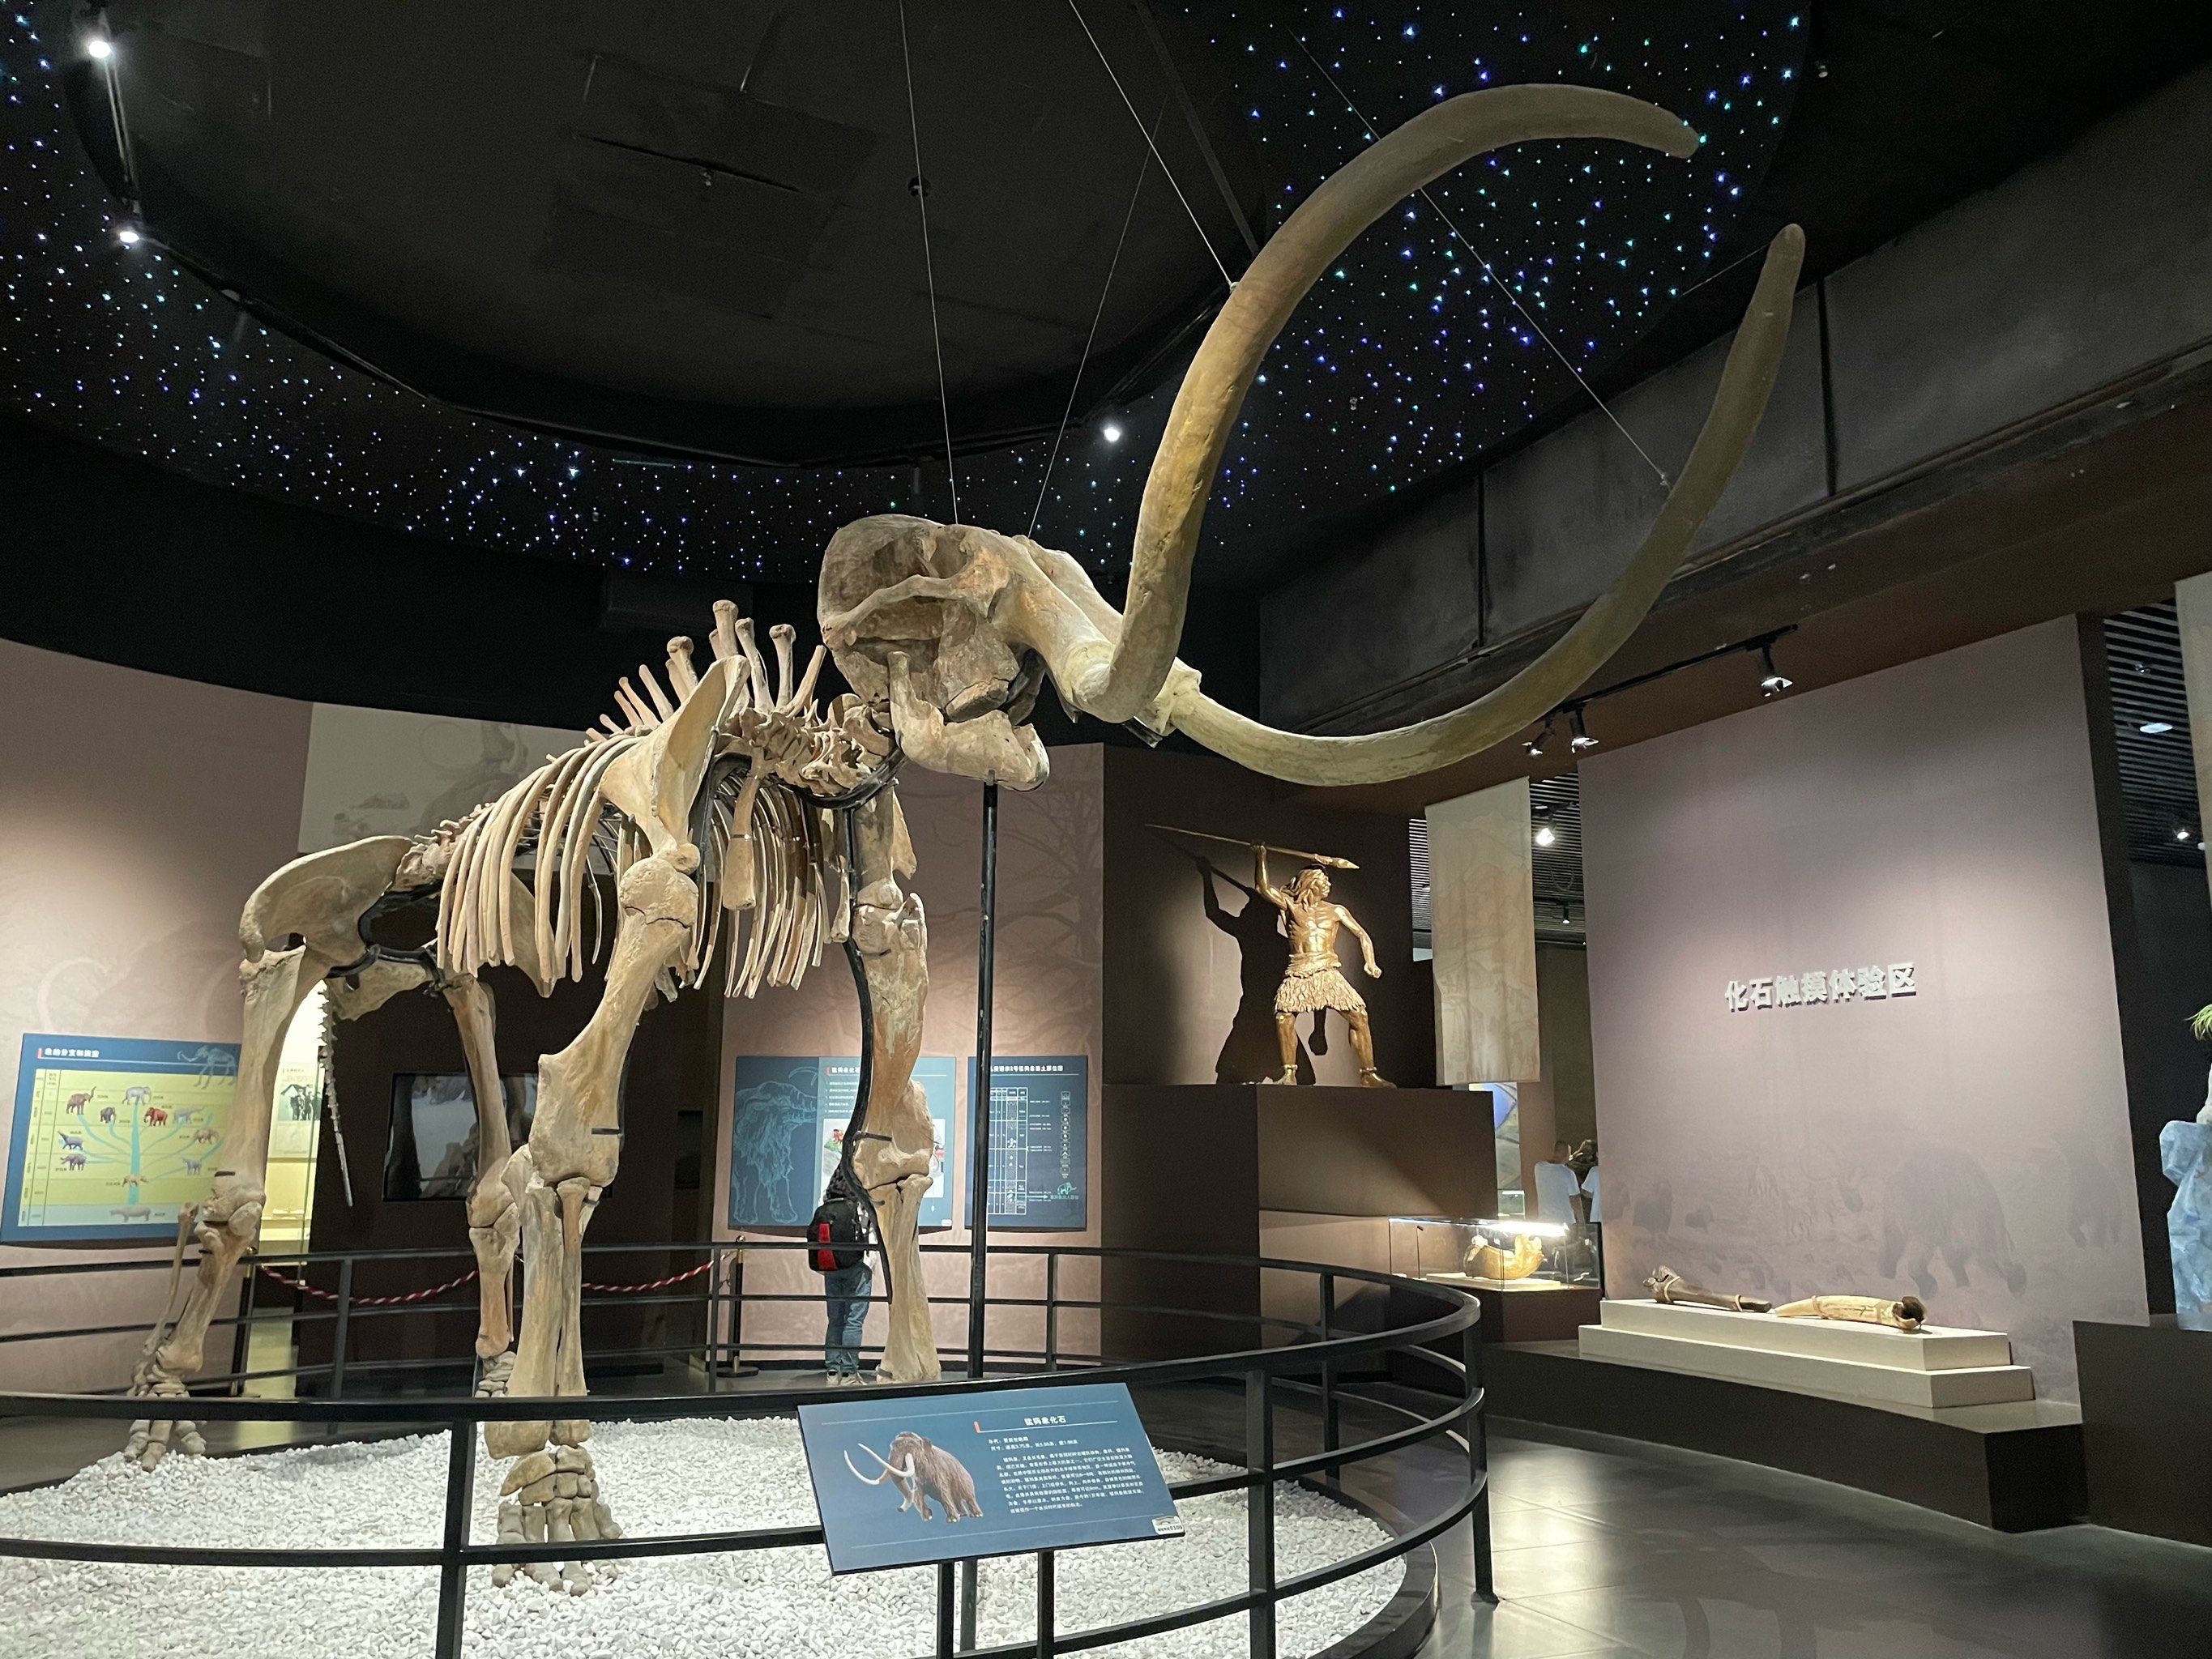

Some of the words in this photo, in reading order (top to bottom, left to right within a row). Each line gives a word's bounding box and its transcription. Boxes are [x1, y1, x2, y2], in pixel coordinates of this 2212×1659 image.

[1724, 962, 1917, 1013] 化石触摸体验区
[1023, 1415, 1066, 1426] 猛犸象化石
